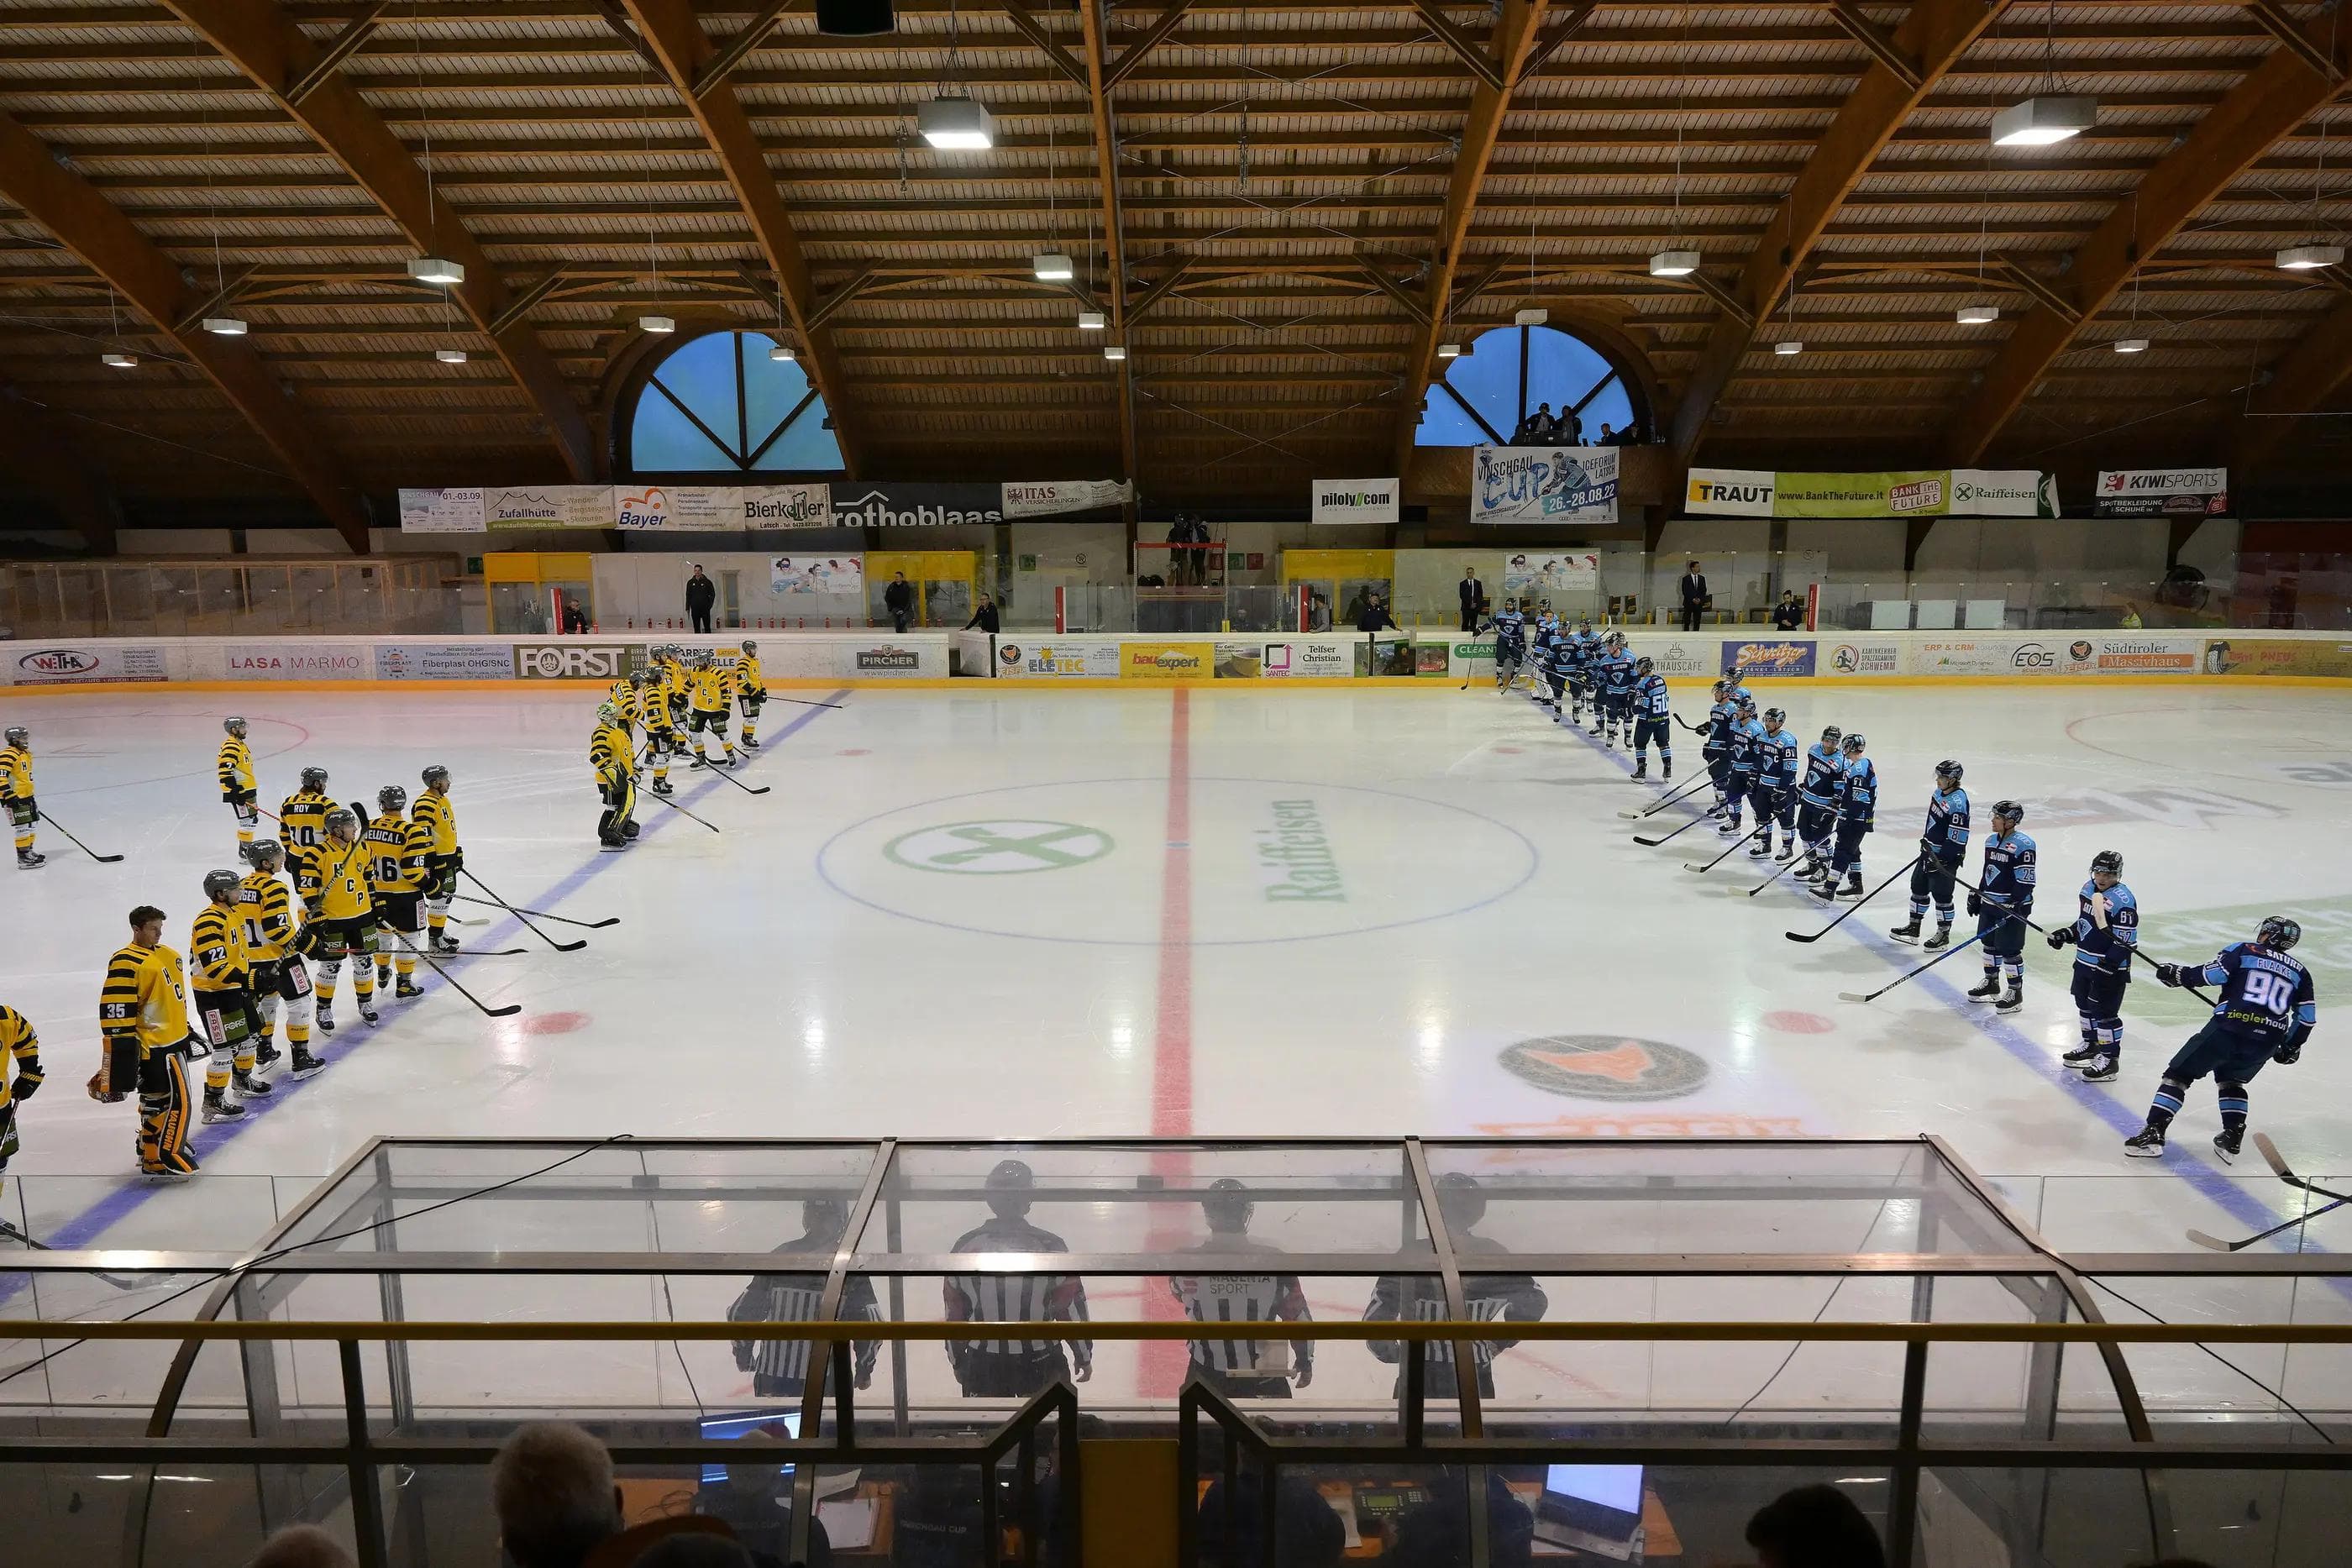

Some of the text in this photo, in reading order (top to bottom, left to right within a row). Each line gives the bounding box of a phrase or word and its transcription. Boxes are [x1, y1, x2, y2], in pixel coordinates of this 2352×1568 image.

[1478, 455, 1533, 481] VINSCHGAU
[1583, 453, 1616, 472] ICEFORUM
[1594, 465, 1616, 480] LATSCH
[1025, 487, 1056, 499] ITAS
[1483, 462, 1550, 510] CUP
[1892, 482, 1940, 497] BANK THE
[1976, 487, 2036, 499] Raiffeisen
[443, 492, 483, 501] 01.-03.09.
[1699, 485, 1773, 503] TRAUT
[1778, 490, 1883, 501] www.BankTheFuture.it
[1025, 497, 1080, 506] VERSICHERUNGEN
[1893, 496, 1940, 510] FUTURE
[498, 508, 557, 519] Zufallhütte
[618, 511, 667, 528] Bayer
[832, 503, 1002, 527] rothoblaas
[1308, 645, 1336, 653] Telfser
[2103, 642, 2170, 654] Südtiroler
[231, 657, 359, 669] LASA MARMO
[423, 660, 466, 669] Fiberplast
[519, 647, 626, 678] FORST
[1028, 659, 1086, 673] ELETEC
[1132, 653, 1200, 670] bauexpert
[1652, 662, 1702, 671] ATHAUSCAFE
[1860, 662, 1896, 671] SCHWEMM
[2015, 653, 2055, 667] EOS
[2108, 656, 2181, 667] Massivhaus
[1652, 694, 1667, 714] 50
[1813, 760, 1830, 774] SATURN
[294, 805, 310, 813] ROY
[1250, 799, 1349, 904] Raiffeisen
[412, 855, 425, 867] 46
[2023, 868, 2035, 880] 25
[301, 876, 313, 888] 24
[346, 879, 354, 893] C
[356, 891, 364, 907] P
[277, 914, 288, 926] 21
[231, 927, 238, 945] H
[208, 946, 225, 962] 22
[2265, 949, 2304, 973] SATURN
[2257, 957, 2292, 978] FLAAKE
[162, 968, 183, 1002] H C
[2243, 971, 2294, 1016] 90
[107, 1004, 126, 1019] 35
[207, 1010, 223, 1045] FASSI
[224, 1017, 246, 1032] FORST
[162, 1109, 179, 1151] VAUGHN
[1210, 1284, 1252, 1295] SPORT
